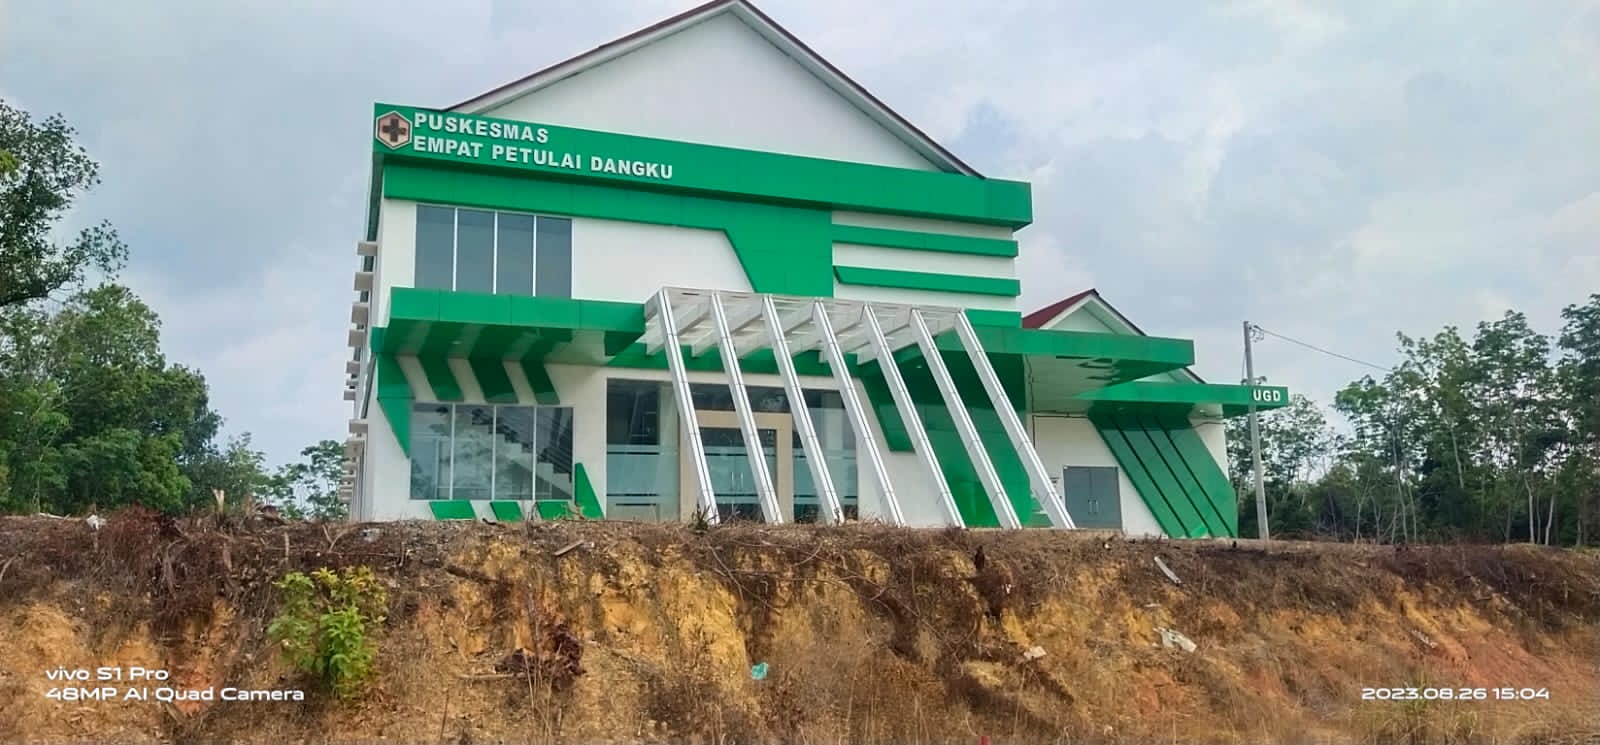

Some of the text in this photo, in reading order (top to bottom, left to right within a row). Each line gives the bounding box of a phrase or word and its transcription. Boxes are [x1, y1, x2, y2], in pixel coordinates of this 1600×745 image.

[414, 112, 549, 143] PUSKESMAS
[413, 136, 673, 179] EMPAT PETULAI DANGKU
[1253, 389, 1280, 402] UGD
